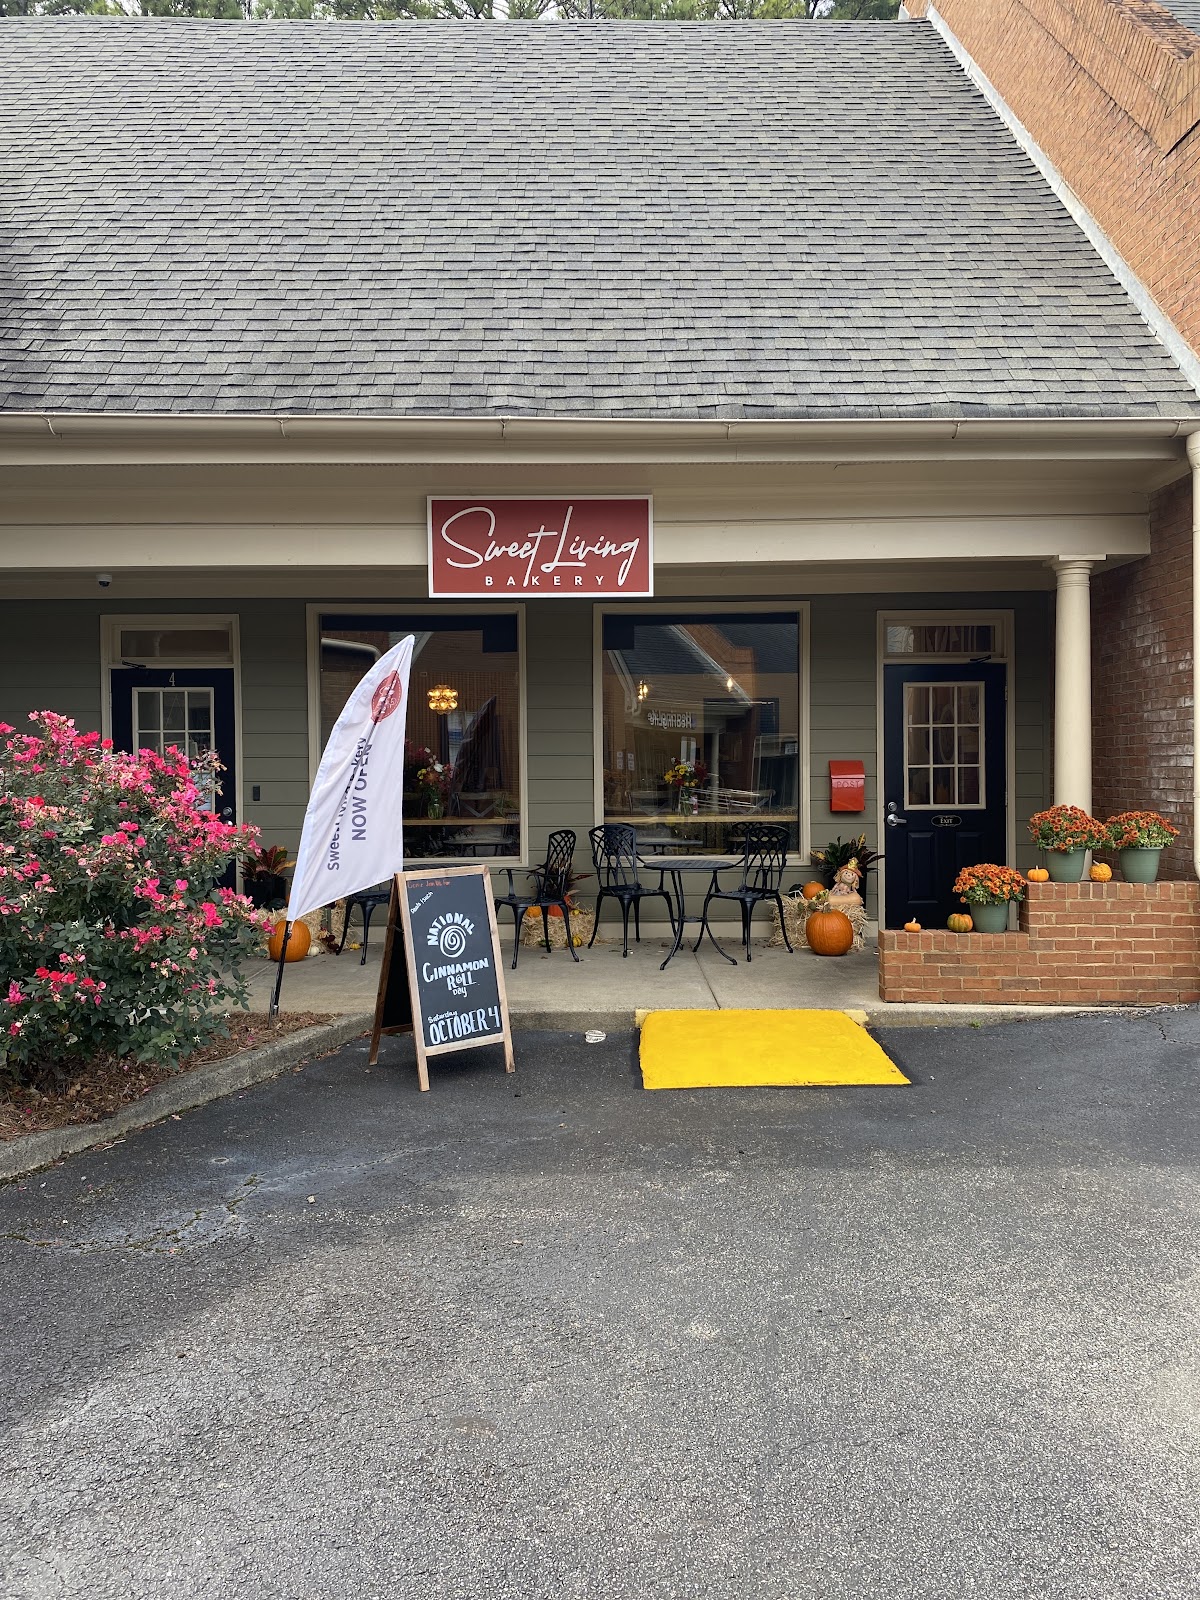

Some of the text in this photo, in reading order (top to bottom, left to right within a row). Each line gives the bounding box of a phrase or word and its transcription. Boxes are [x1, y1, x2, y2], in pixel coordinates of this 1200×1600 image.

[441, 505, 640, 587] Sweet Living
[485, 576, 605, 586] BAKERY
[168, 672, 175, 687] 4
[836, 780, 860, 789] POST
[352, 796, 367, 841] NOW
[427, 911, 476, 946] NATIONAL
[422, 957, 489, 983] CINNAMON
[446, 971, 476, 991] ROLL
[428, 1010, 458, 1024] Saturday
[429, 1005, 500, 1045] OCTOBER 4
